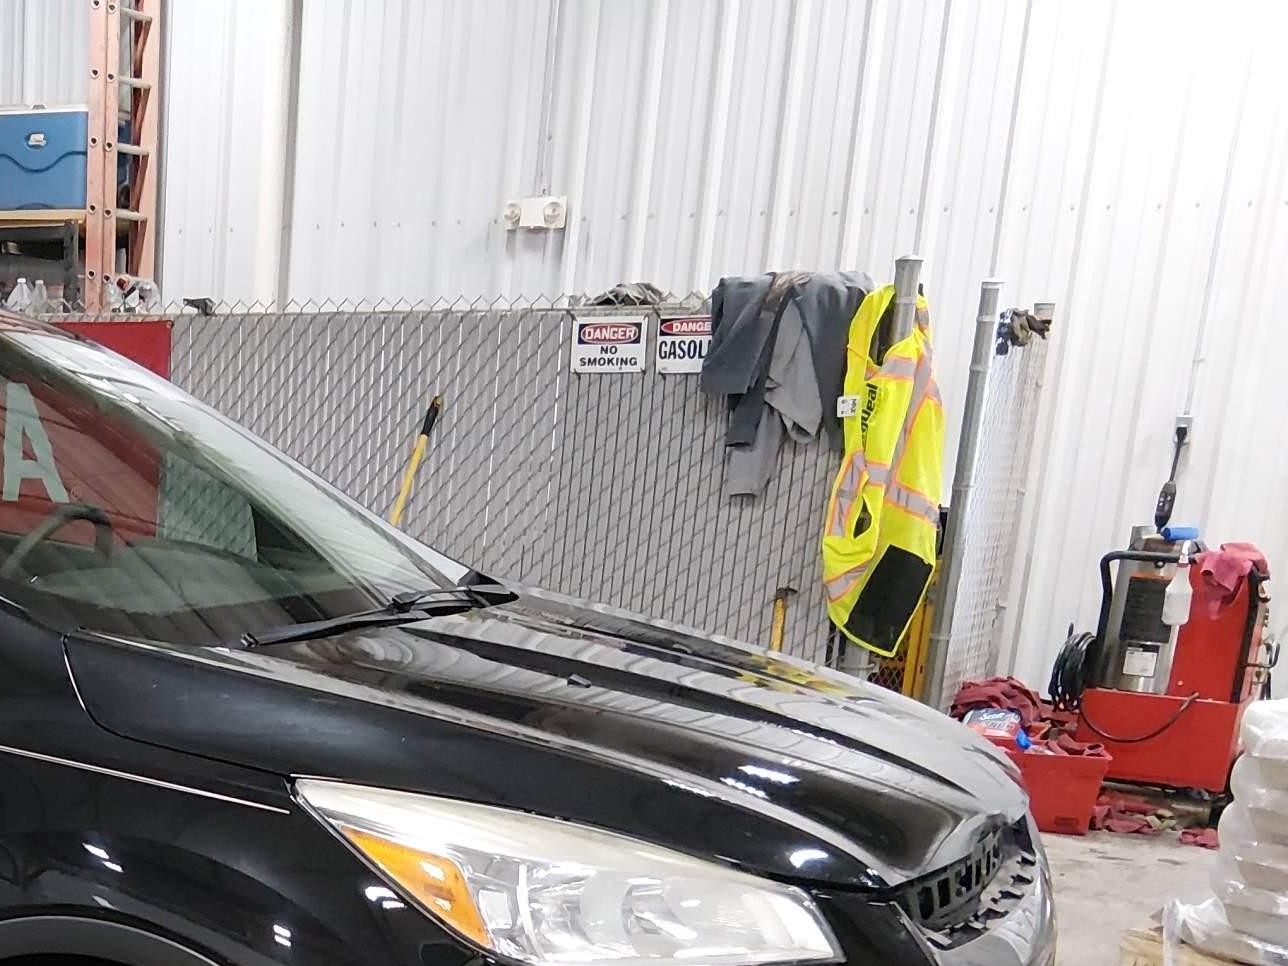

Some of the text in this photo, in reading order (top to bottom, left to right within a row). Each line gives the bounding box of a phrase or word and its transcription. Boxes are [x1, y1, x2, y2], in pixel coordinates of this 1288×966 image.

[672, 321, 712, 333] DANGE
[585, 327, 635, 340] DANGER
[600, 346, 618, 355] NO
[658, 340, 712, 360] GASOL
[580, 357, 638, 367] SMOKING
